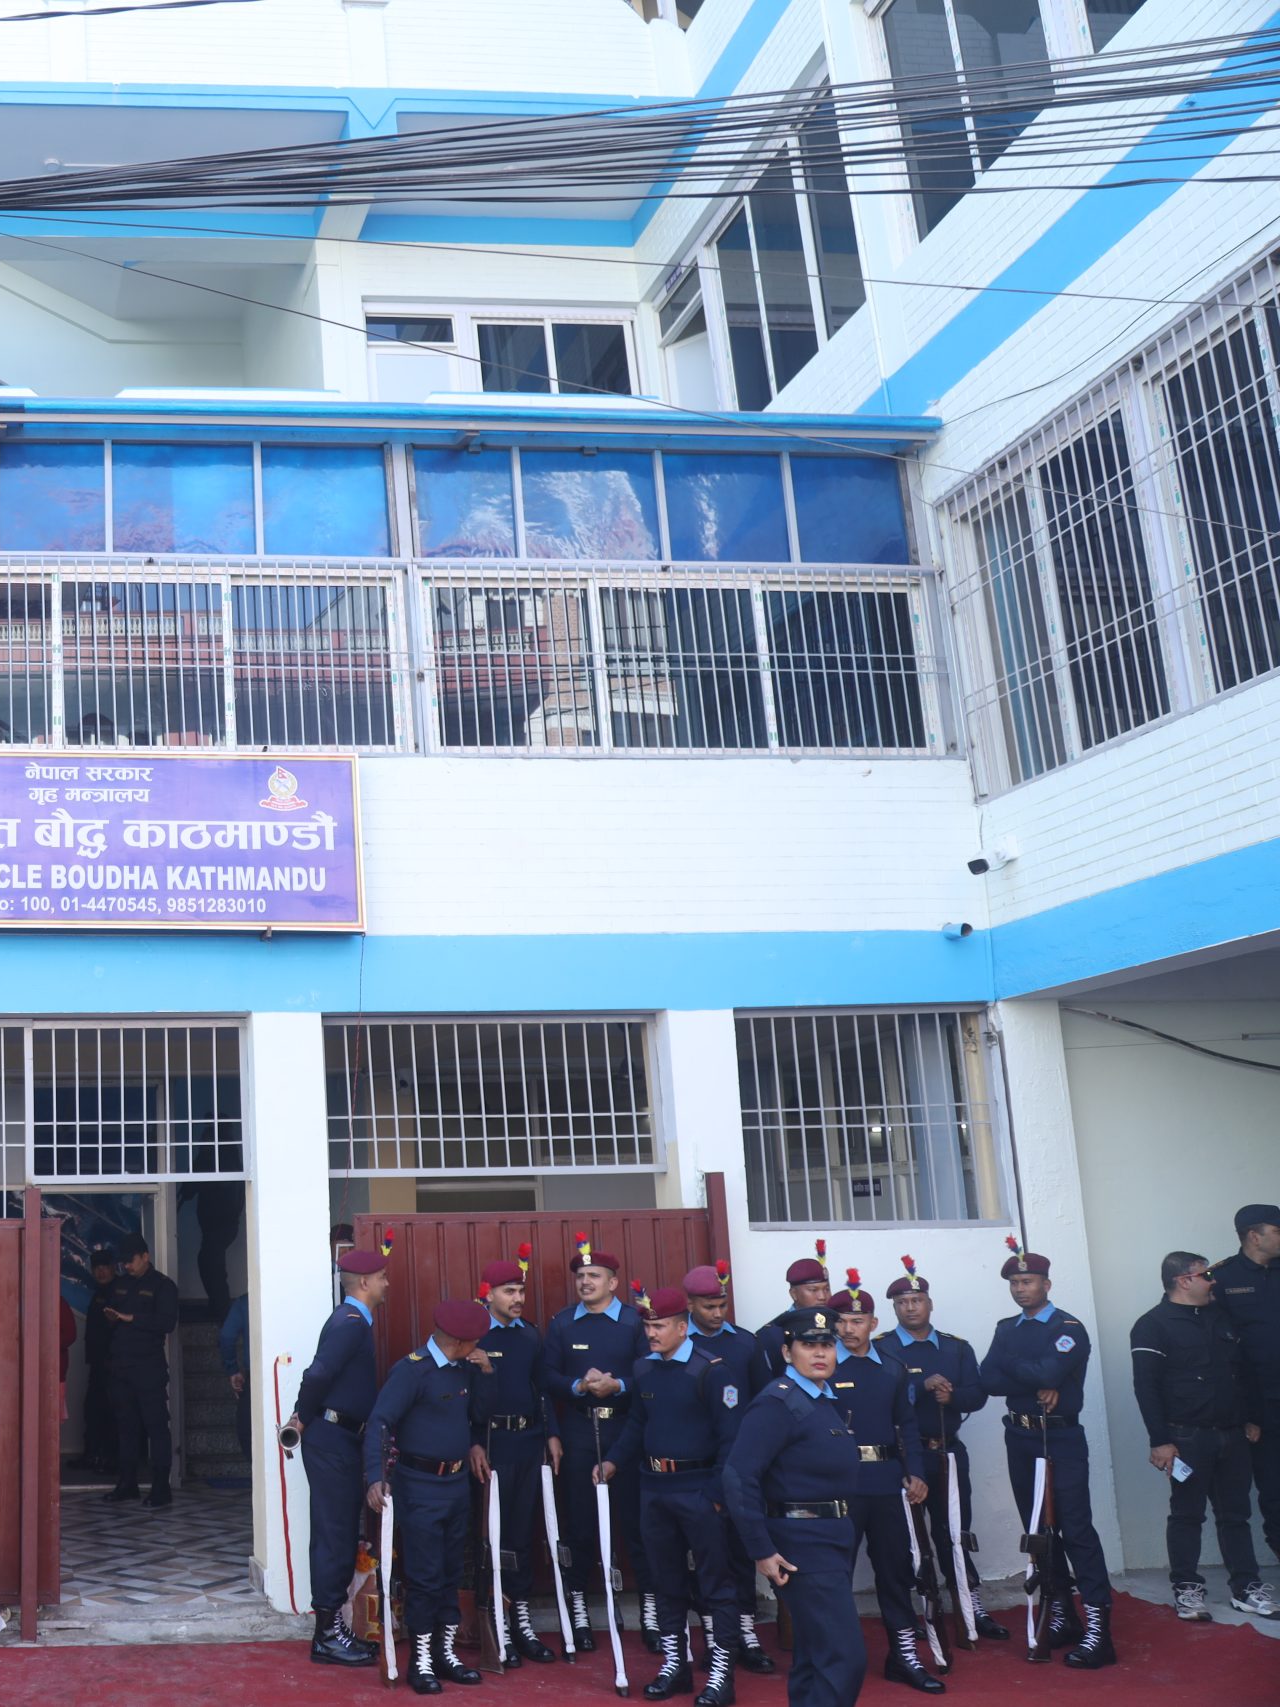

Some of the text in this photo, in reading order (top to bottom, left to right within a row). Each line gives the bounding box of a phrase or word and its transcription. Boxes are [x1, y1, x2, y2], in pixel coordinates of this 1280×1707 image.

[24, 762, 154, 782] नेपाल सरकार
[28, 787, 151, 806] गृह मन्त्रालय
[123, 810, 338, 851] काठमाण्डौ
[51, 864, 159, 890] BOUDHA
[166, 866, 326, 891] KATHMANDU
[21, 896, 55, 914] 100,
[60, 896, 162, 915] 01-4470545,
[166, 898, 267, 913] 9851283010
